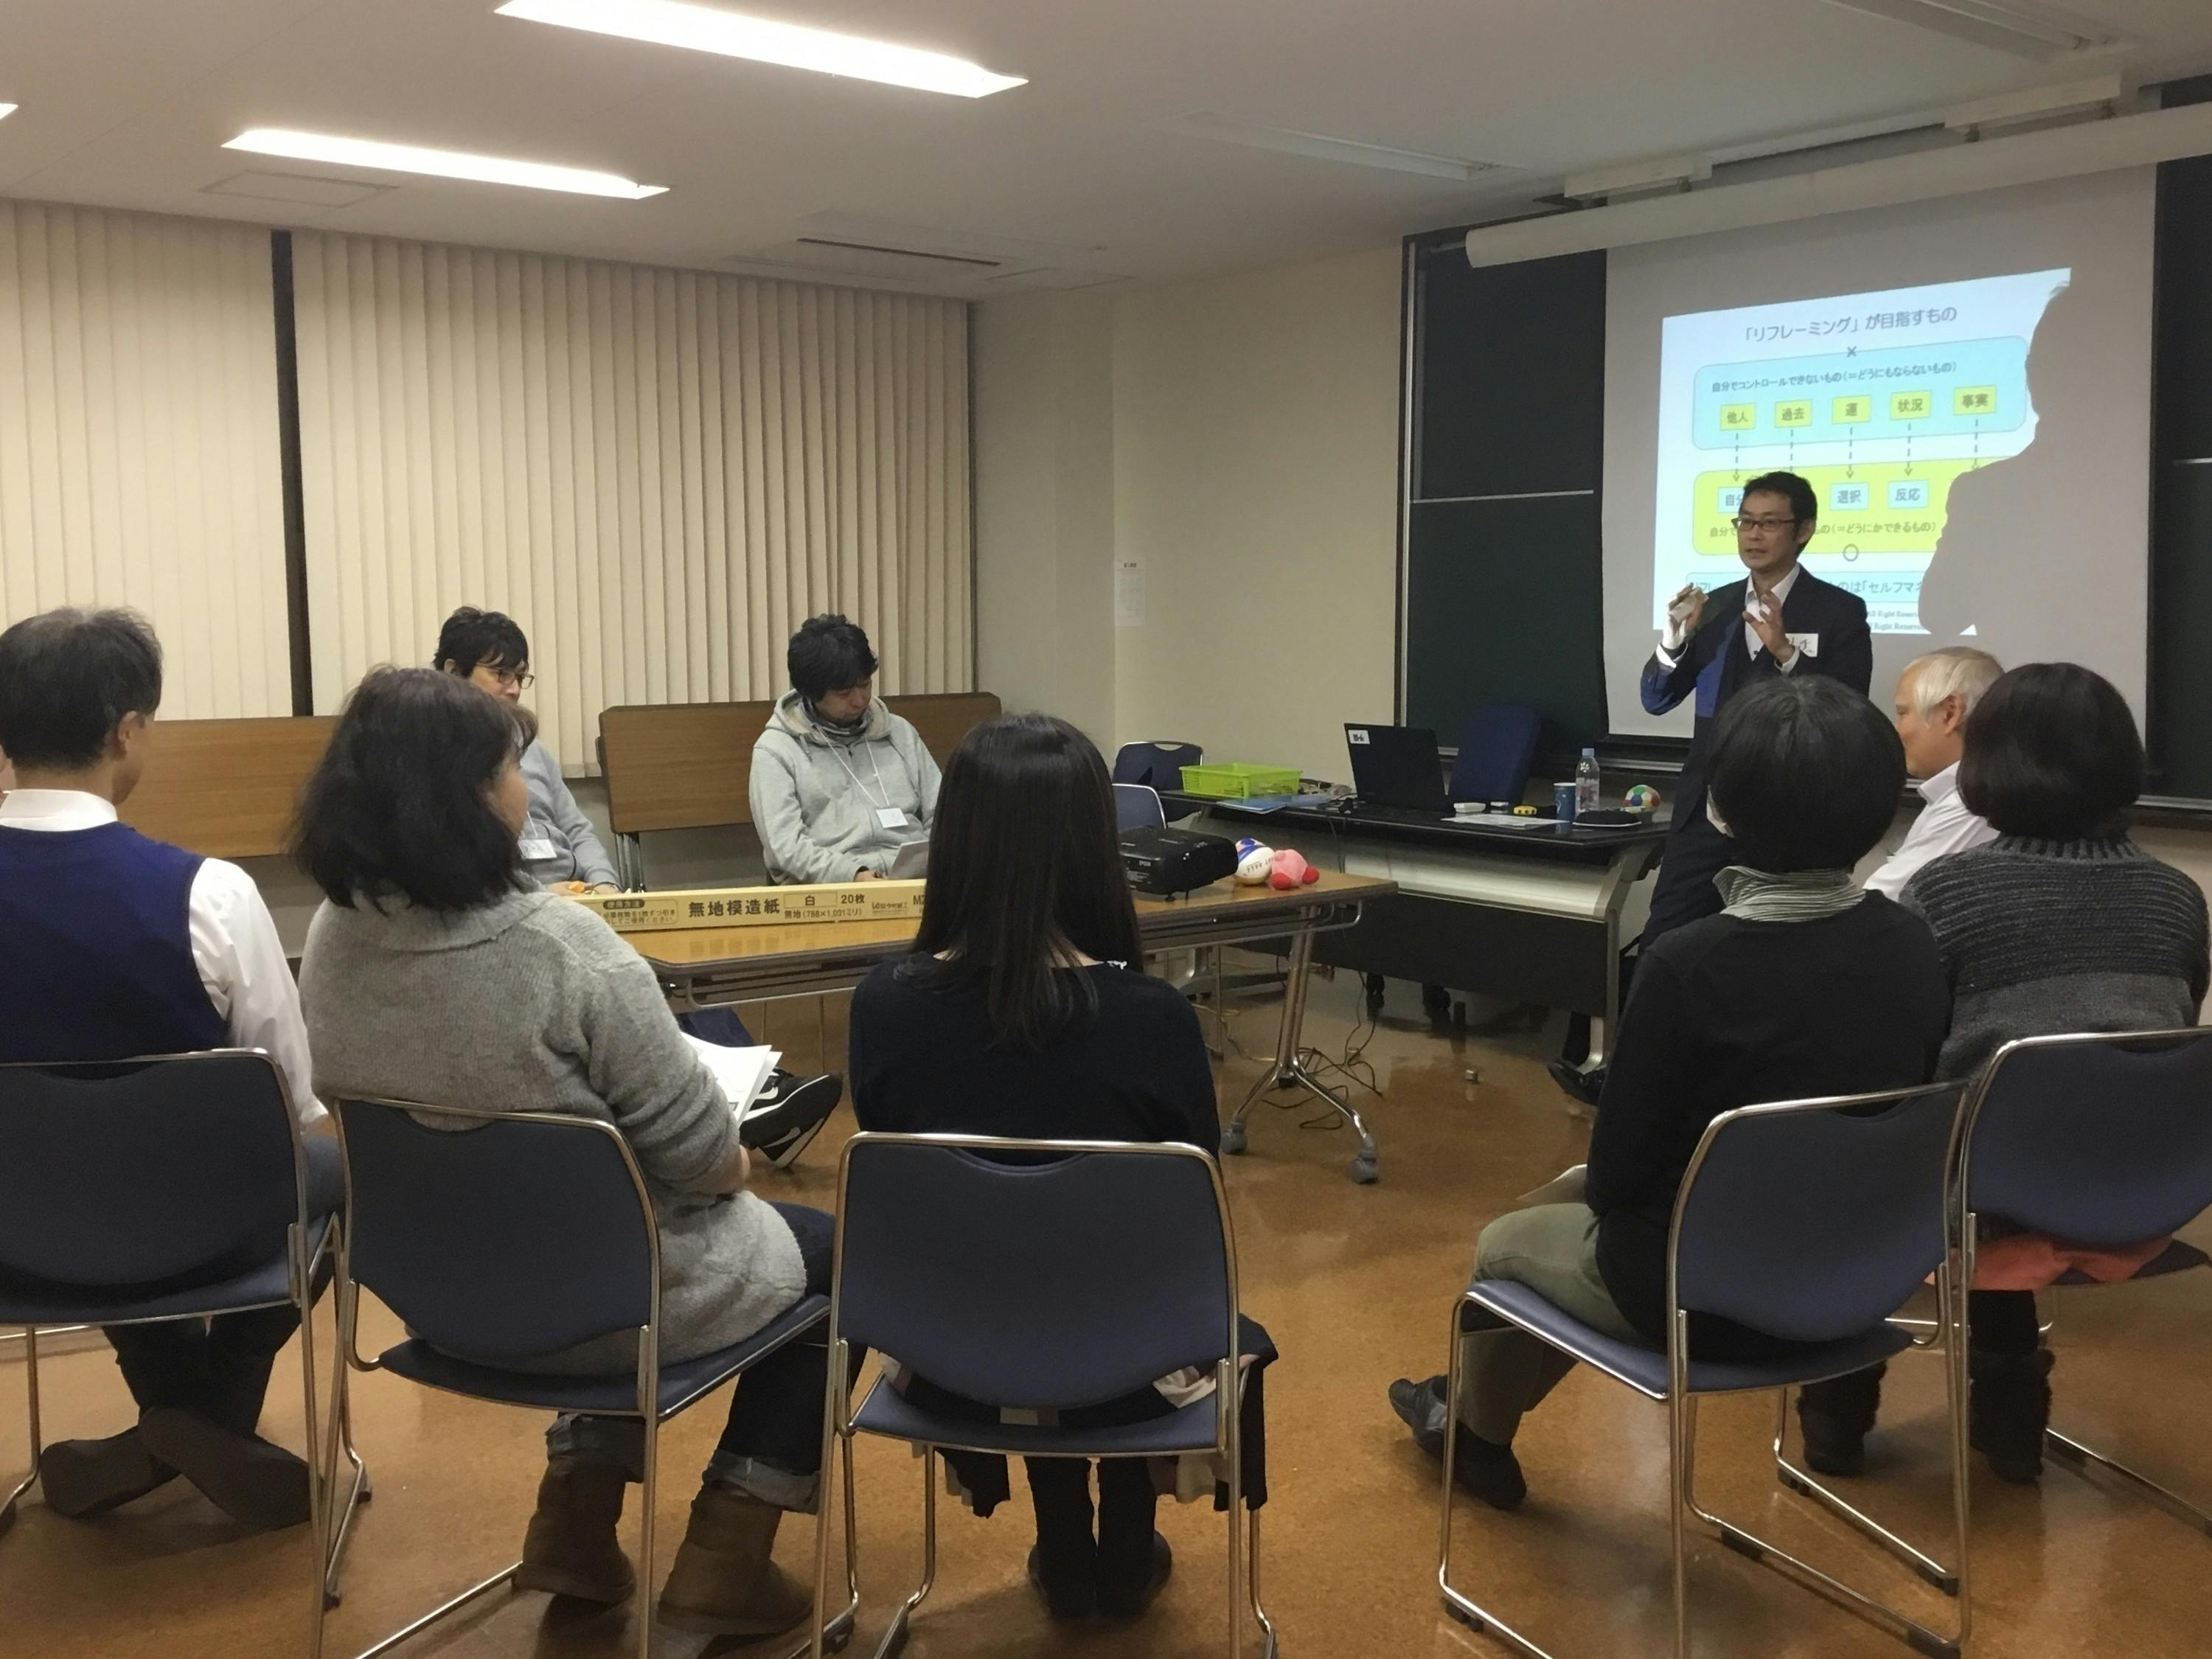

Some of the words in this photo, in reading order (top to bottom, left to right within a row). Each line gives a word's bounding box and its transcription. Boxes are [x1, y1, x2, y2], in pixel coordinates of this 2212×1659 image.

[1745, 306, 1958, 341] 「リフレーミング」が目指すもの
[1726, 410, 1748, 424] 他人
[1781, 407, 1806, 422] 過去
[1844, 402, 1859, 417] 運
[1896, 398, 1923, 413] 状況
[1961, 393, 1989, 408] 事実
[1837, 490, 1862, 504] 選択
[1894, 487, 1921, 502] 反応
[689, 899, 780, 918] 無地模造紙
[804, 895, 815, 906] 白
[841, 894, 865, 905] 20枚
